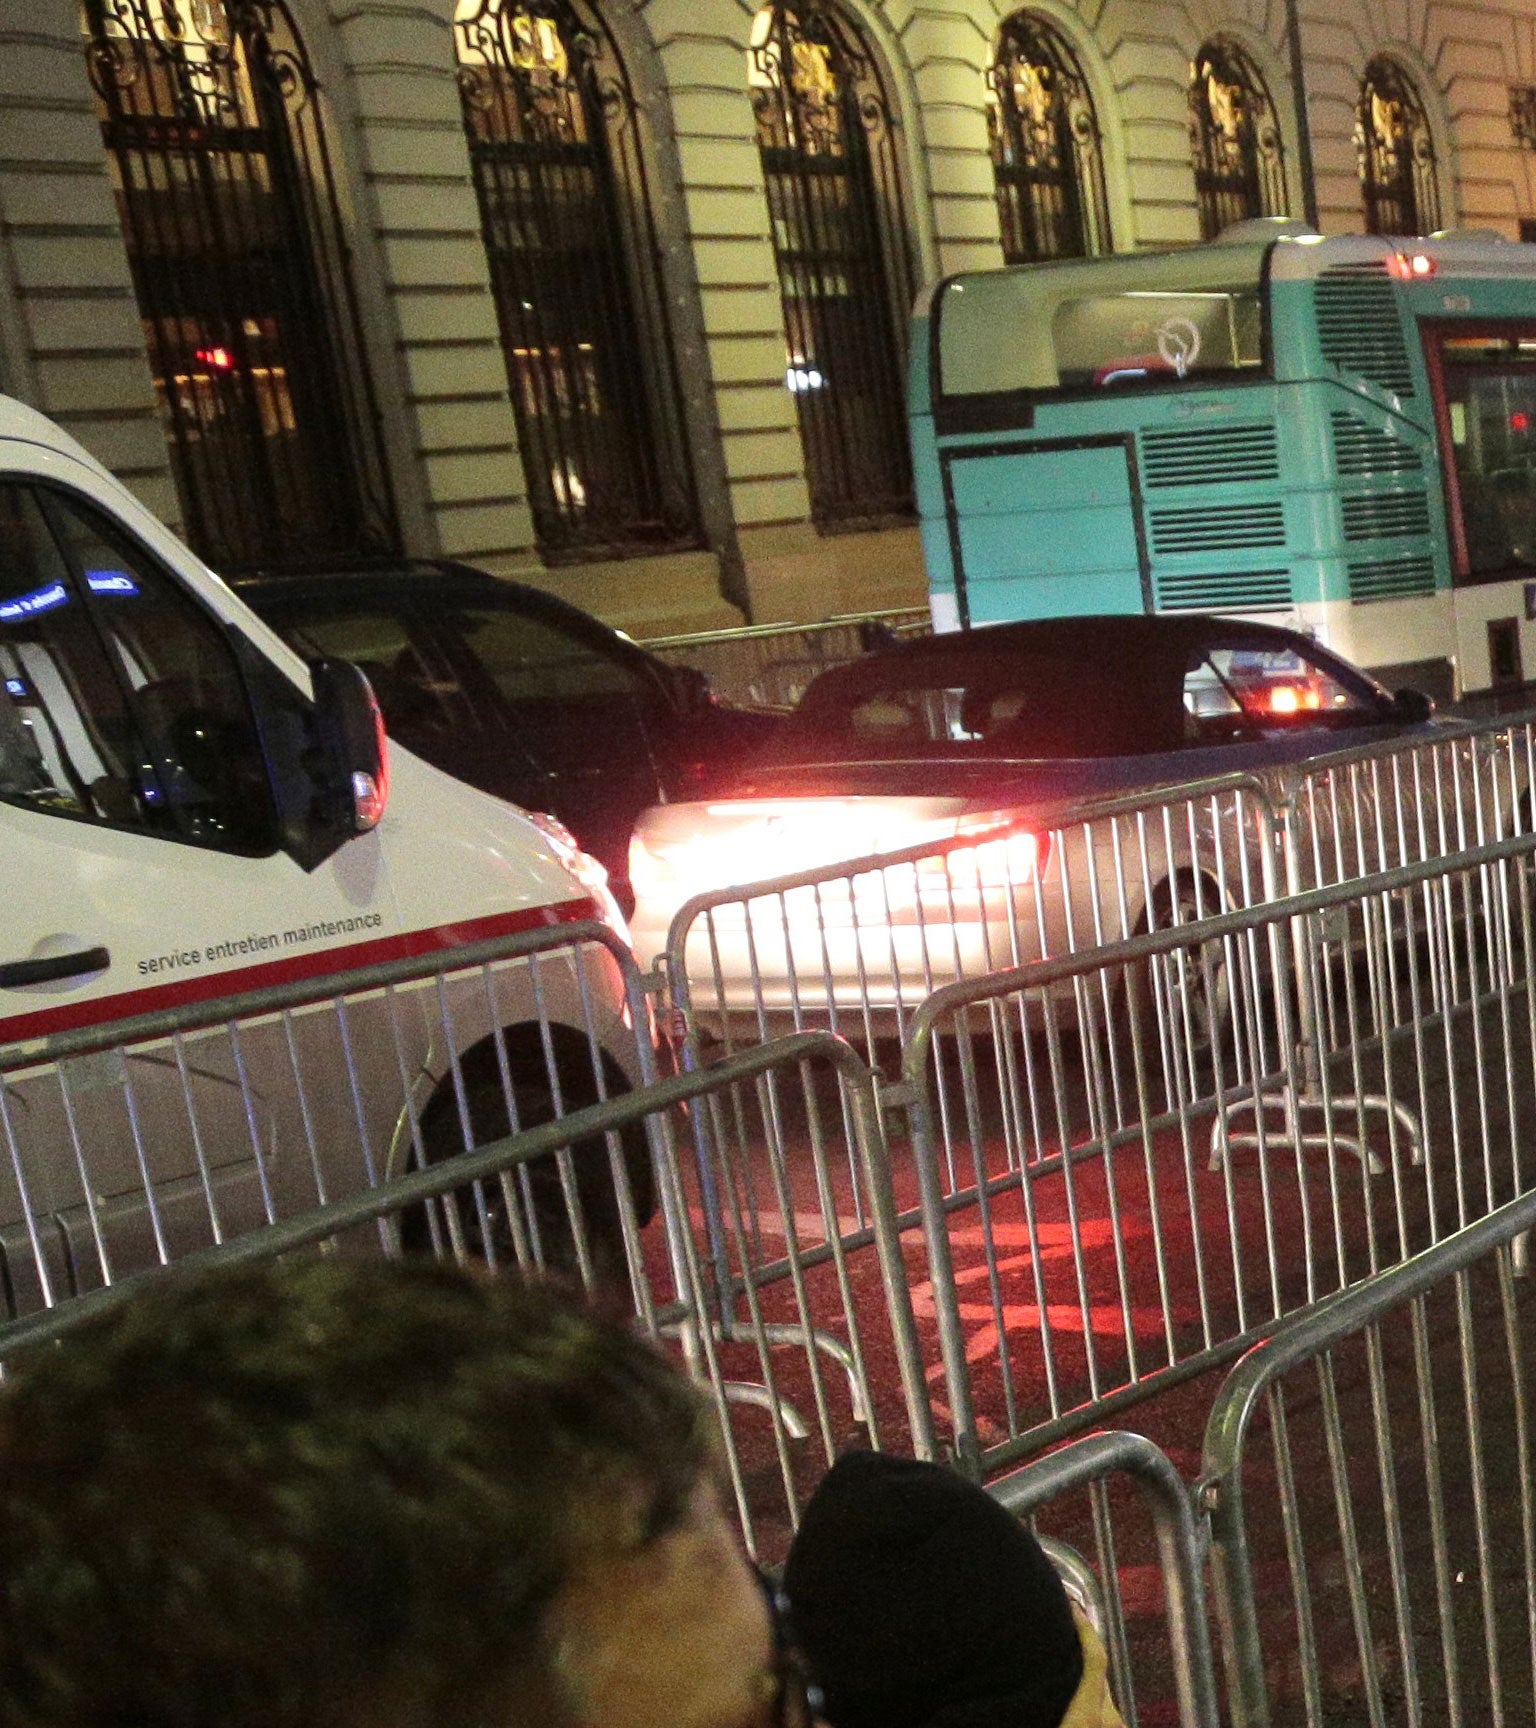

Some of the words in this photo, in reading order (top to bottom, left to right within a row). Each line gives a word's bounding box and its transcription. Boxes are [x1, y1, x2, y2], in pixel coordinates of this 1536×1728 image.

[137, 951, 202, 975] service
[206, 933, 278, 962] entretien
[283, 911, 383, 949] maintenance
